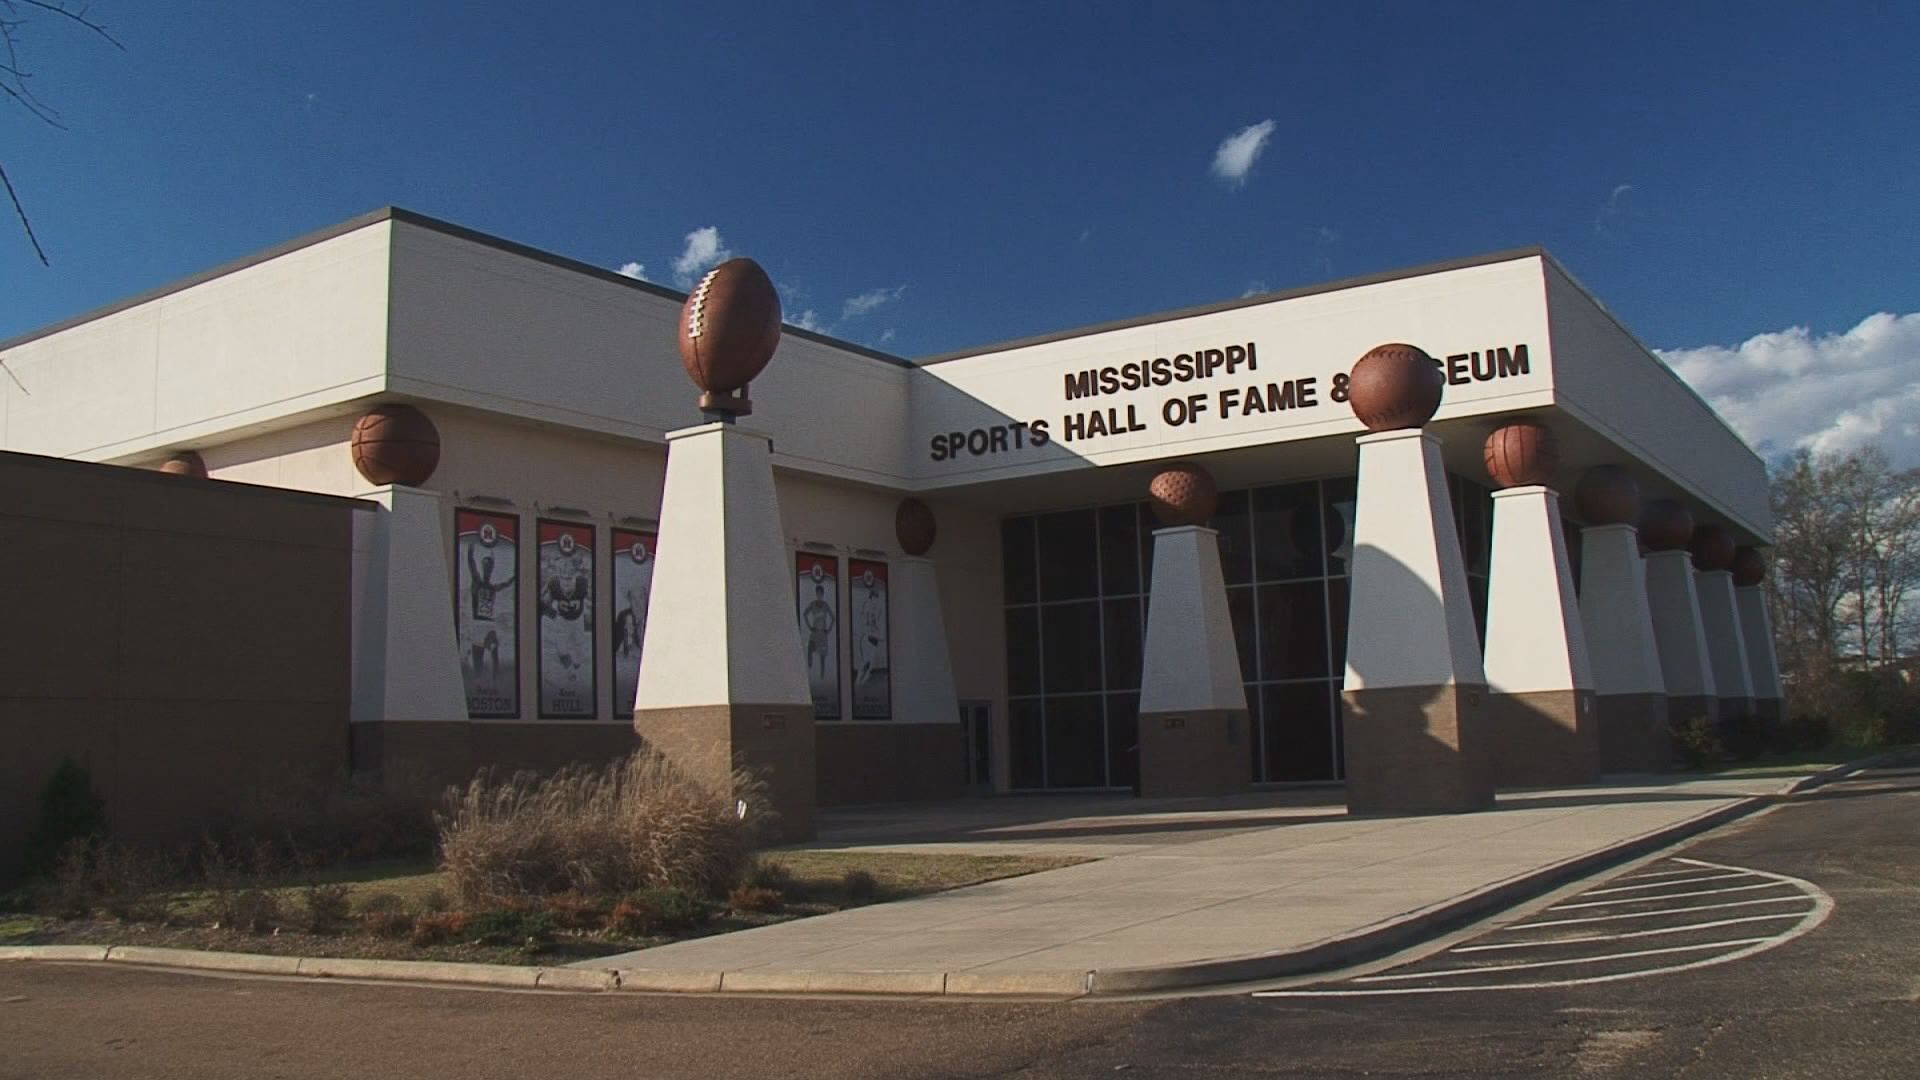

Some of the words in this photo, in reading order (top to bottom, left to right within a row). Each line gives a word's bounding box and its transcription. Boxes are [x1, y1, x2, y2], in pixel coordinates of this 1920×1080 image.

[1064, 342, 1257, 400] MISSISSIPPI
[930, 419, 1050, 461] SPORTS
[1064, 404, 1147, 441] HALL
[1162, 393, 1209, 427] OF
[1219, 377, 1318, 419] FAME
[1330, 373, 1350, 403] &
[1432, 344, 1530, 387] EUM
[551, 699, 583, 712] HULL
